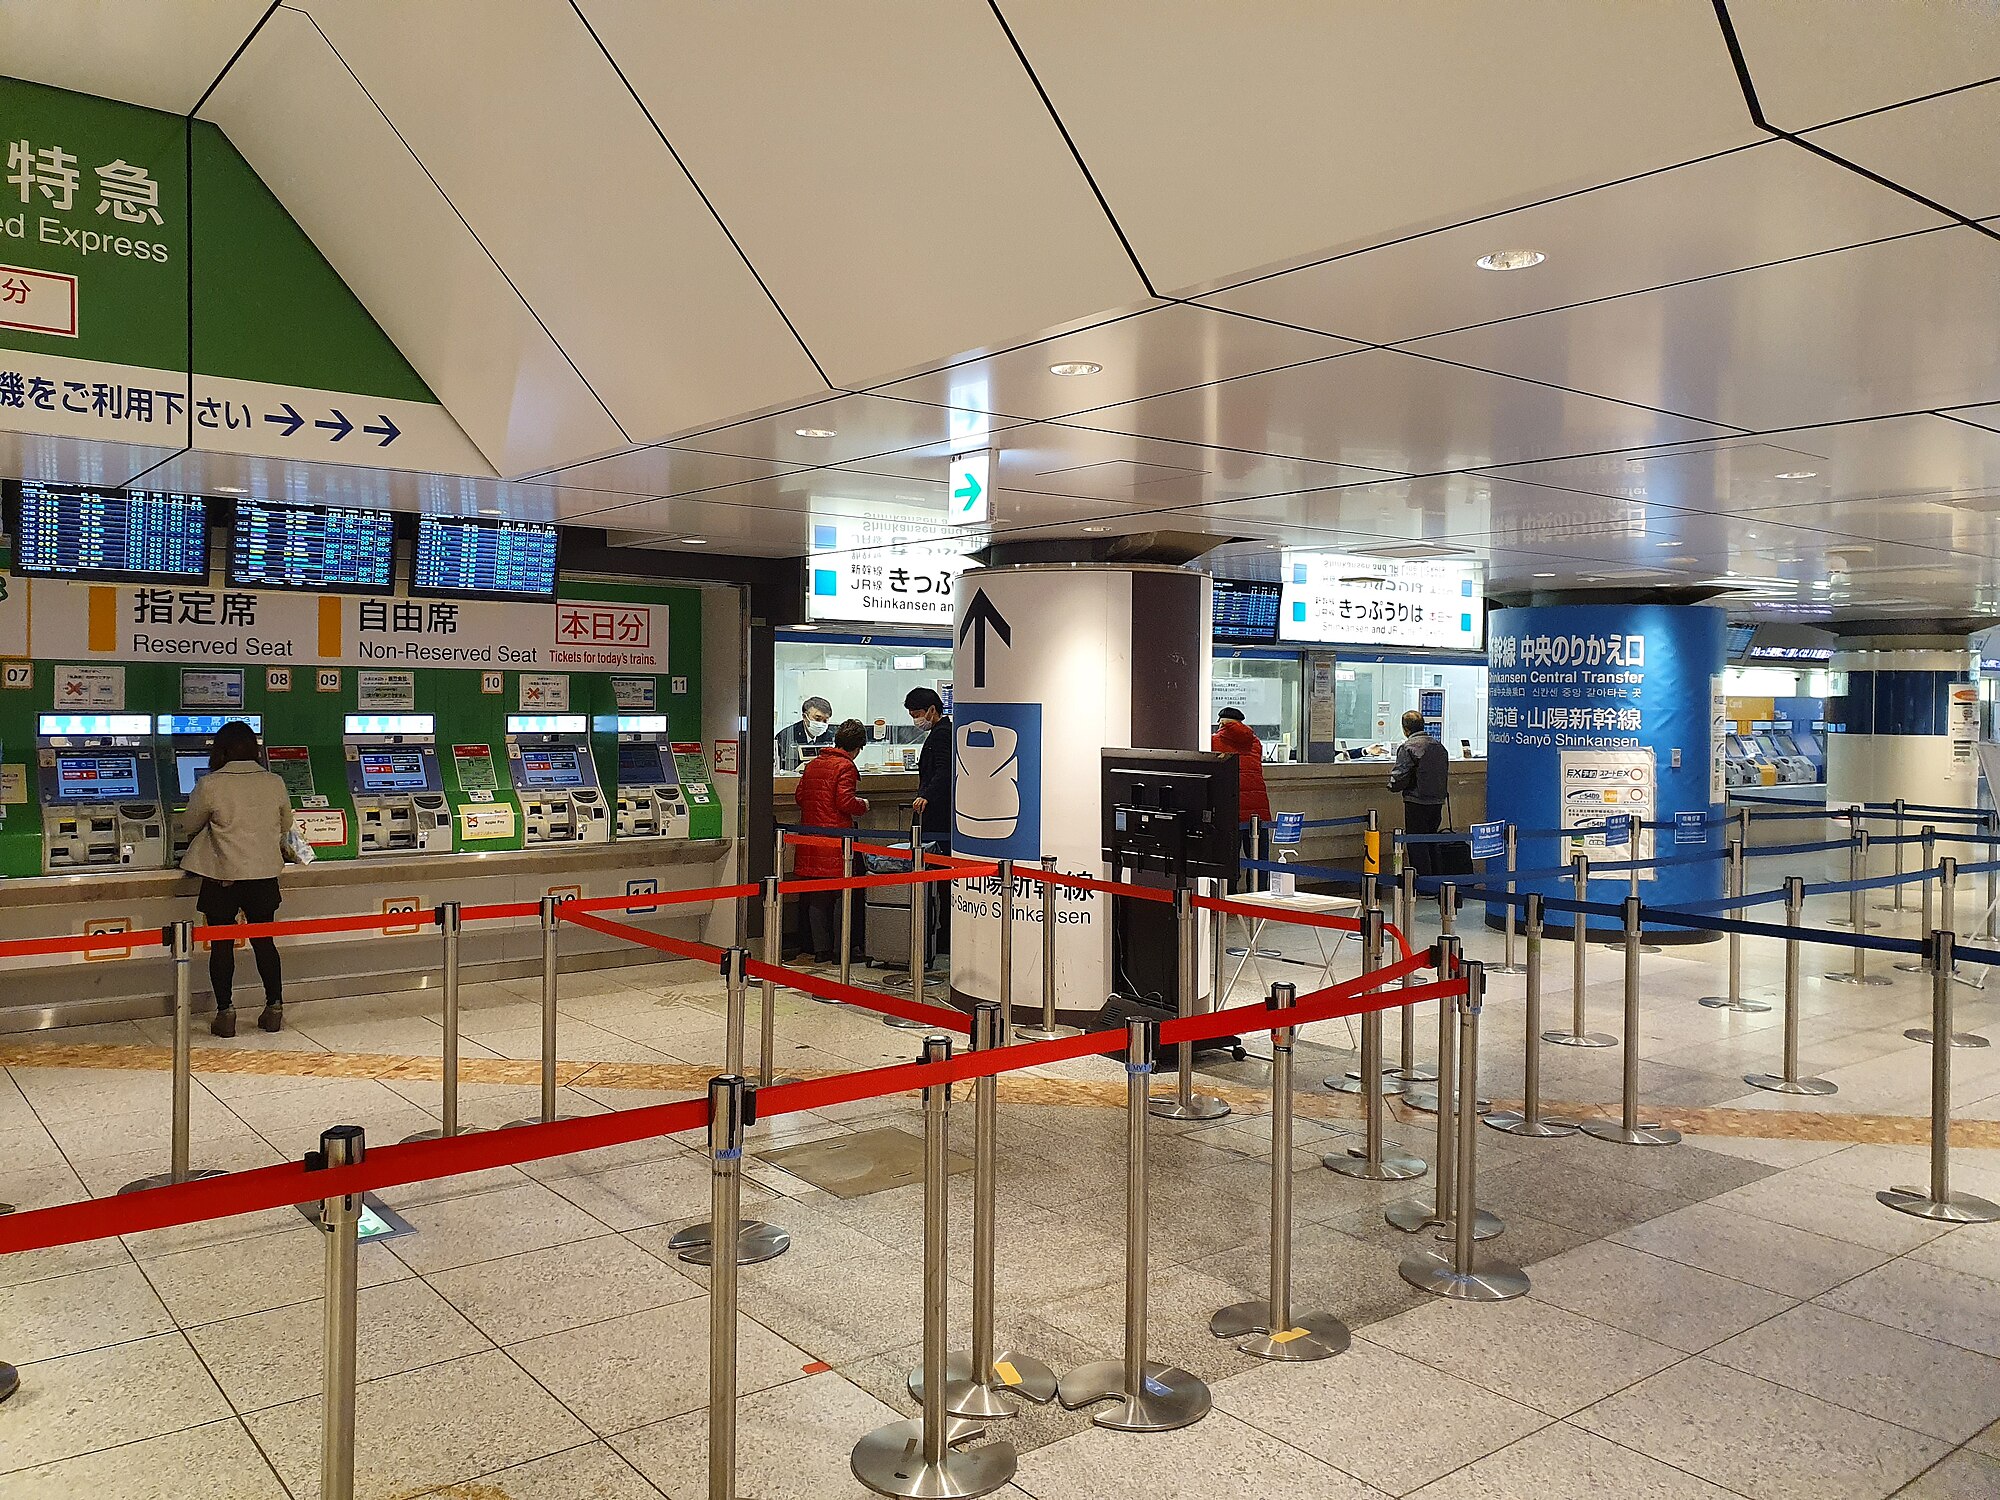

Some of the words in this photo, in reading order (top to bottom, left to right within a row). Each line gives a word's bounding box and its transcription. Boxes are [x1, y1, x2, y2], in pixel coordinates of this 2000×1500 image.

[8, 139, 165, 226] 特急
[0, 213, 25, 239] d
[39, 216, 169, 264] Express
[2, 278, 31, 304] 分
[134, 588, 258, 627] 指定席
[863, 595, 936, 612] Shinkansen
[359, 599, 459, 635] 自由席
[561, 610, 644, 642] 本日分
[1371, 625, 1386, 635] and
[133, 634, 238, 655] Reserved
[245, 637, 293, 657] Seat
[860, 637, 872, 645] 13
[359, 641, 491, 662] Non-Reserved
[497, 645, 538, 664] Seat
[549, 650, 582, 664] Tickets
[583, 650, 596, 663] for
[597, 651, 628, 667] today's
[629, 652, 657, 666] trains.
[1520, 634, 1645, 668] 中央のりかえ口
[7, 668, 29, 682] 07
[269, 673, 289, 685] 08
[320, 674, 338, 686] 09
[484, 677, 501, 690] 10
[1530, 670, 1577, 684] Central
[1581, 670, 1645, 684] Transfer
[672, 680, 687, 692] 11
[1555, 732, 1639, 748] Shinkansen
